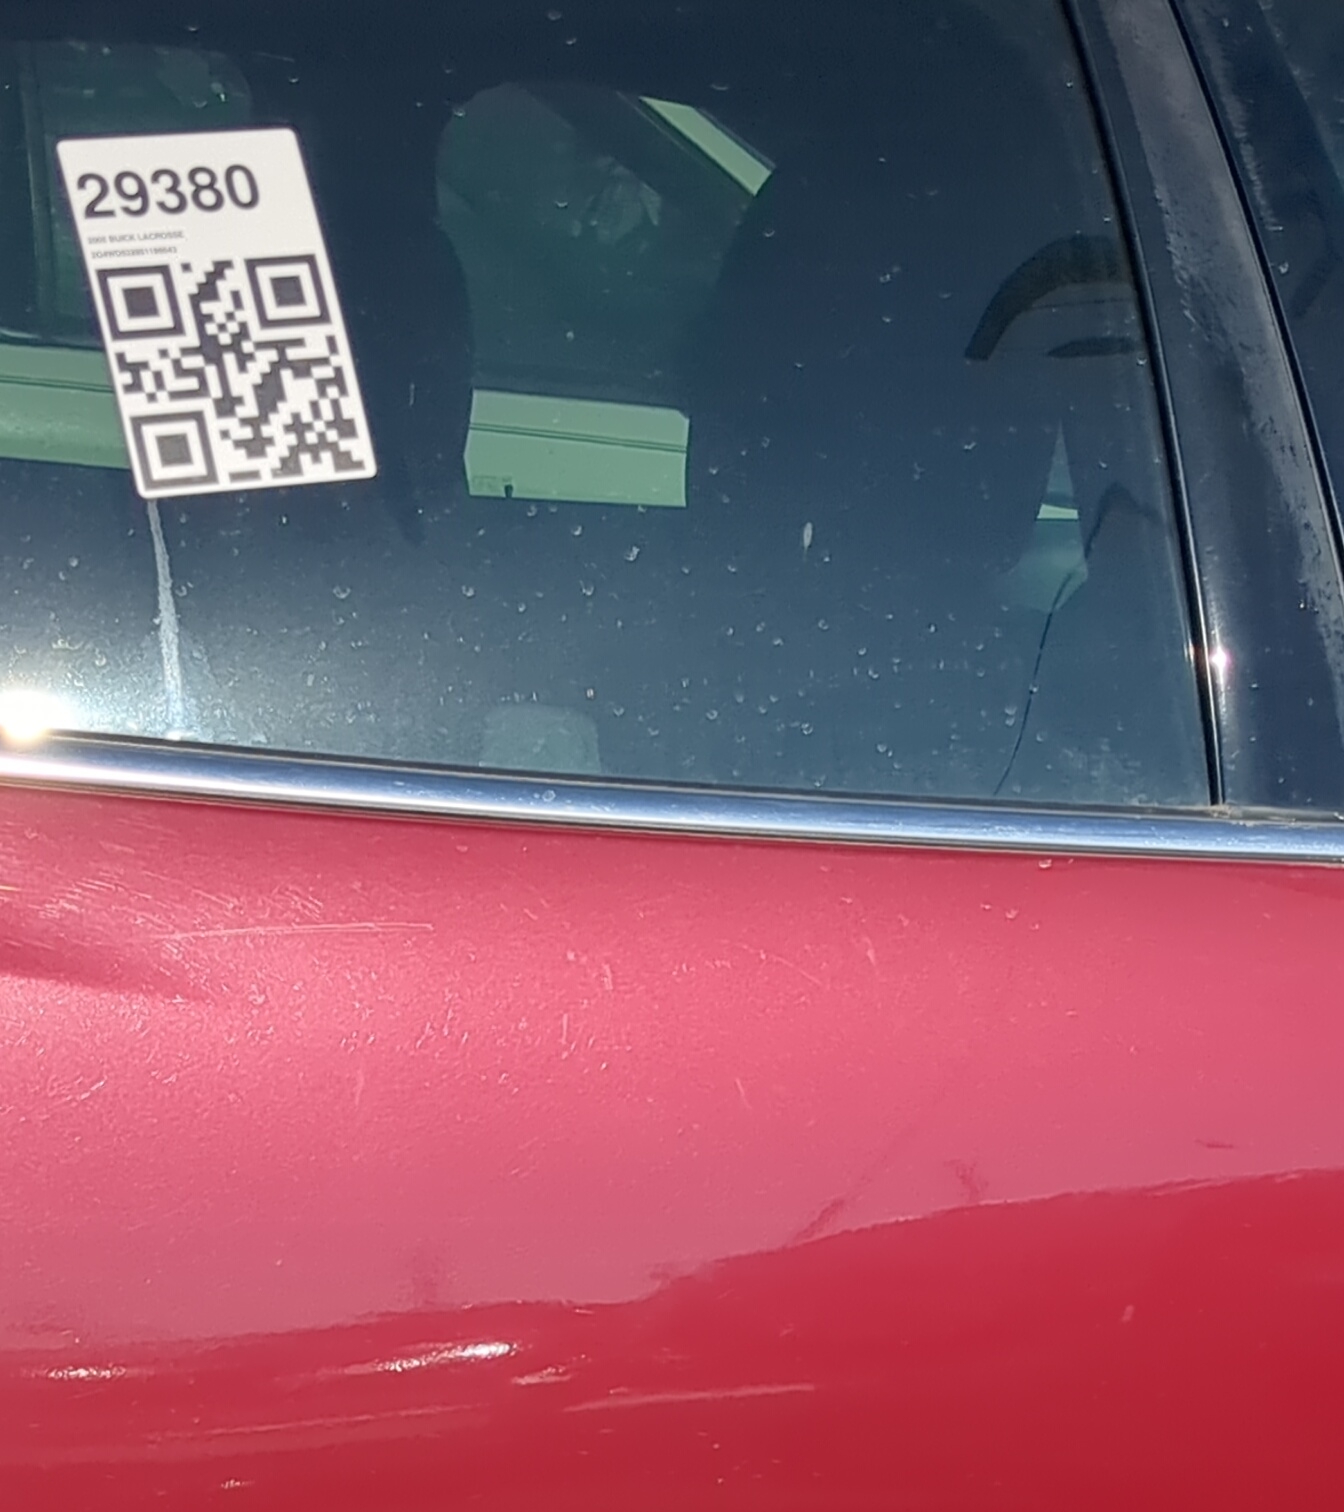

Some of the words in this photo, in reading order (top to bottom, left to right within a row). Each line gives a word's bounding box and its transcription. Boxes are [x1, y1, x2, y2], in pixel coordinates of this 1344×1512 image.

[76, 163, 260, 219] 29380
[109, 233, 136, 243] BUICK
[137, 231, 184, 241] LACROSSE
